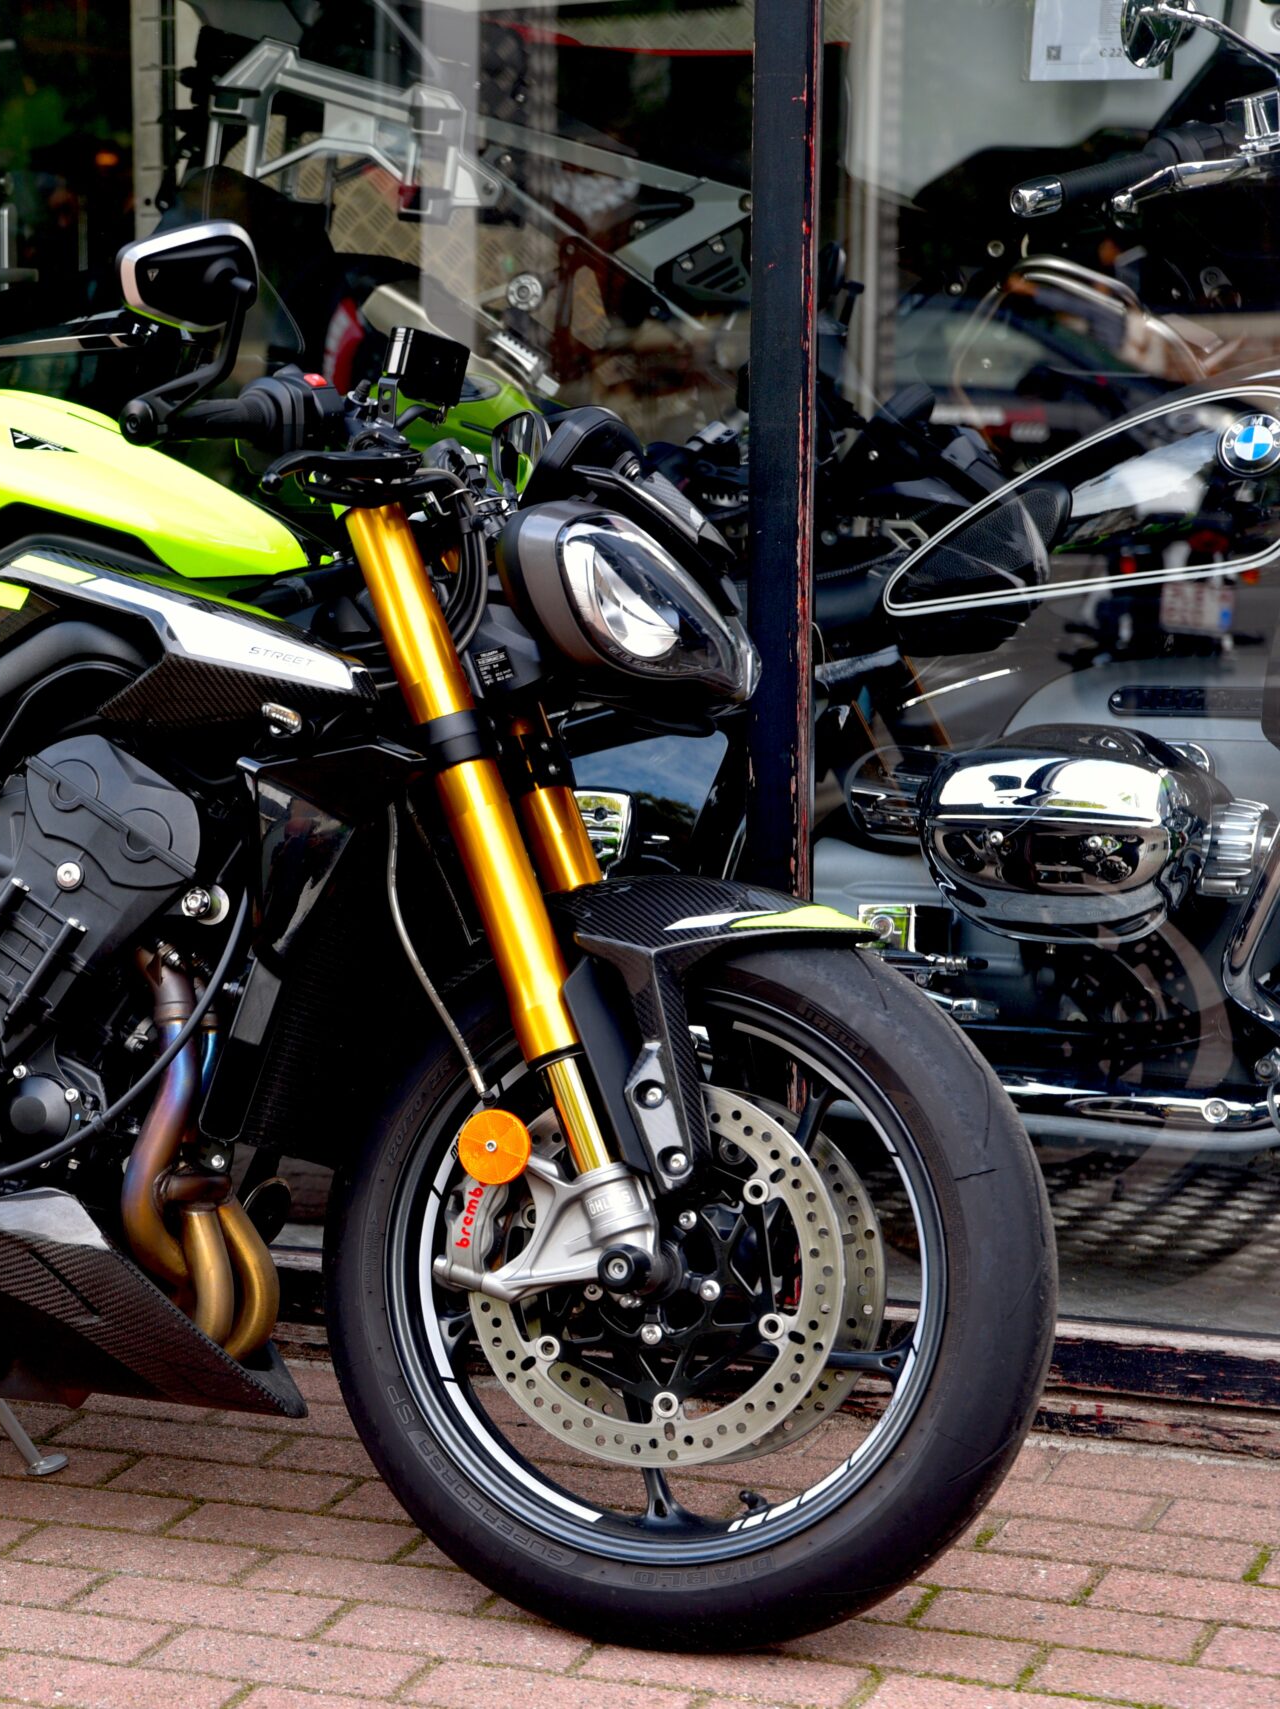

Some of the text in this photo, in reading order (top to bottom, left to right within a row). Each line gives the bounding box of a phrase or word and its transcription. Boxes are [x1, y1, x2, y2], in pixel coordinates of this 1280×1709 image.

[1231, 415, 1280, 436] BMW
[249, 646, 316, 666] STREET
[385, 1097, 424, 1168] 120/70
[588, 1189, 633, 1216] ÖHLS
[386, 1384, 567, 1565] SUPERCORSA SP
[631, 1554, 777, 1587] DIABLO
